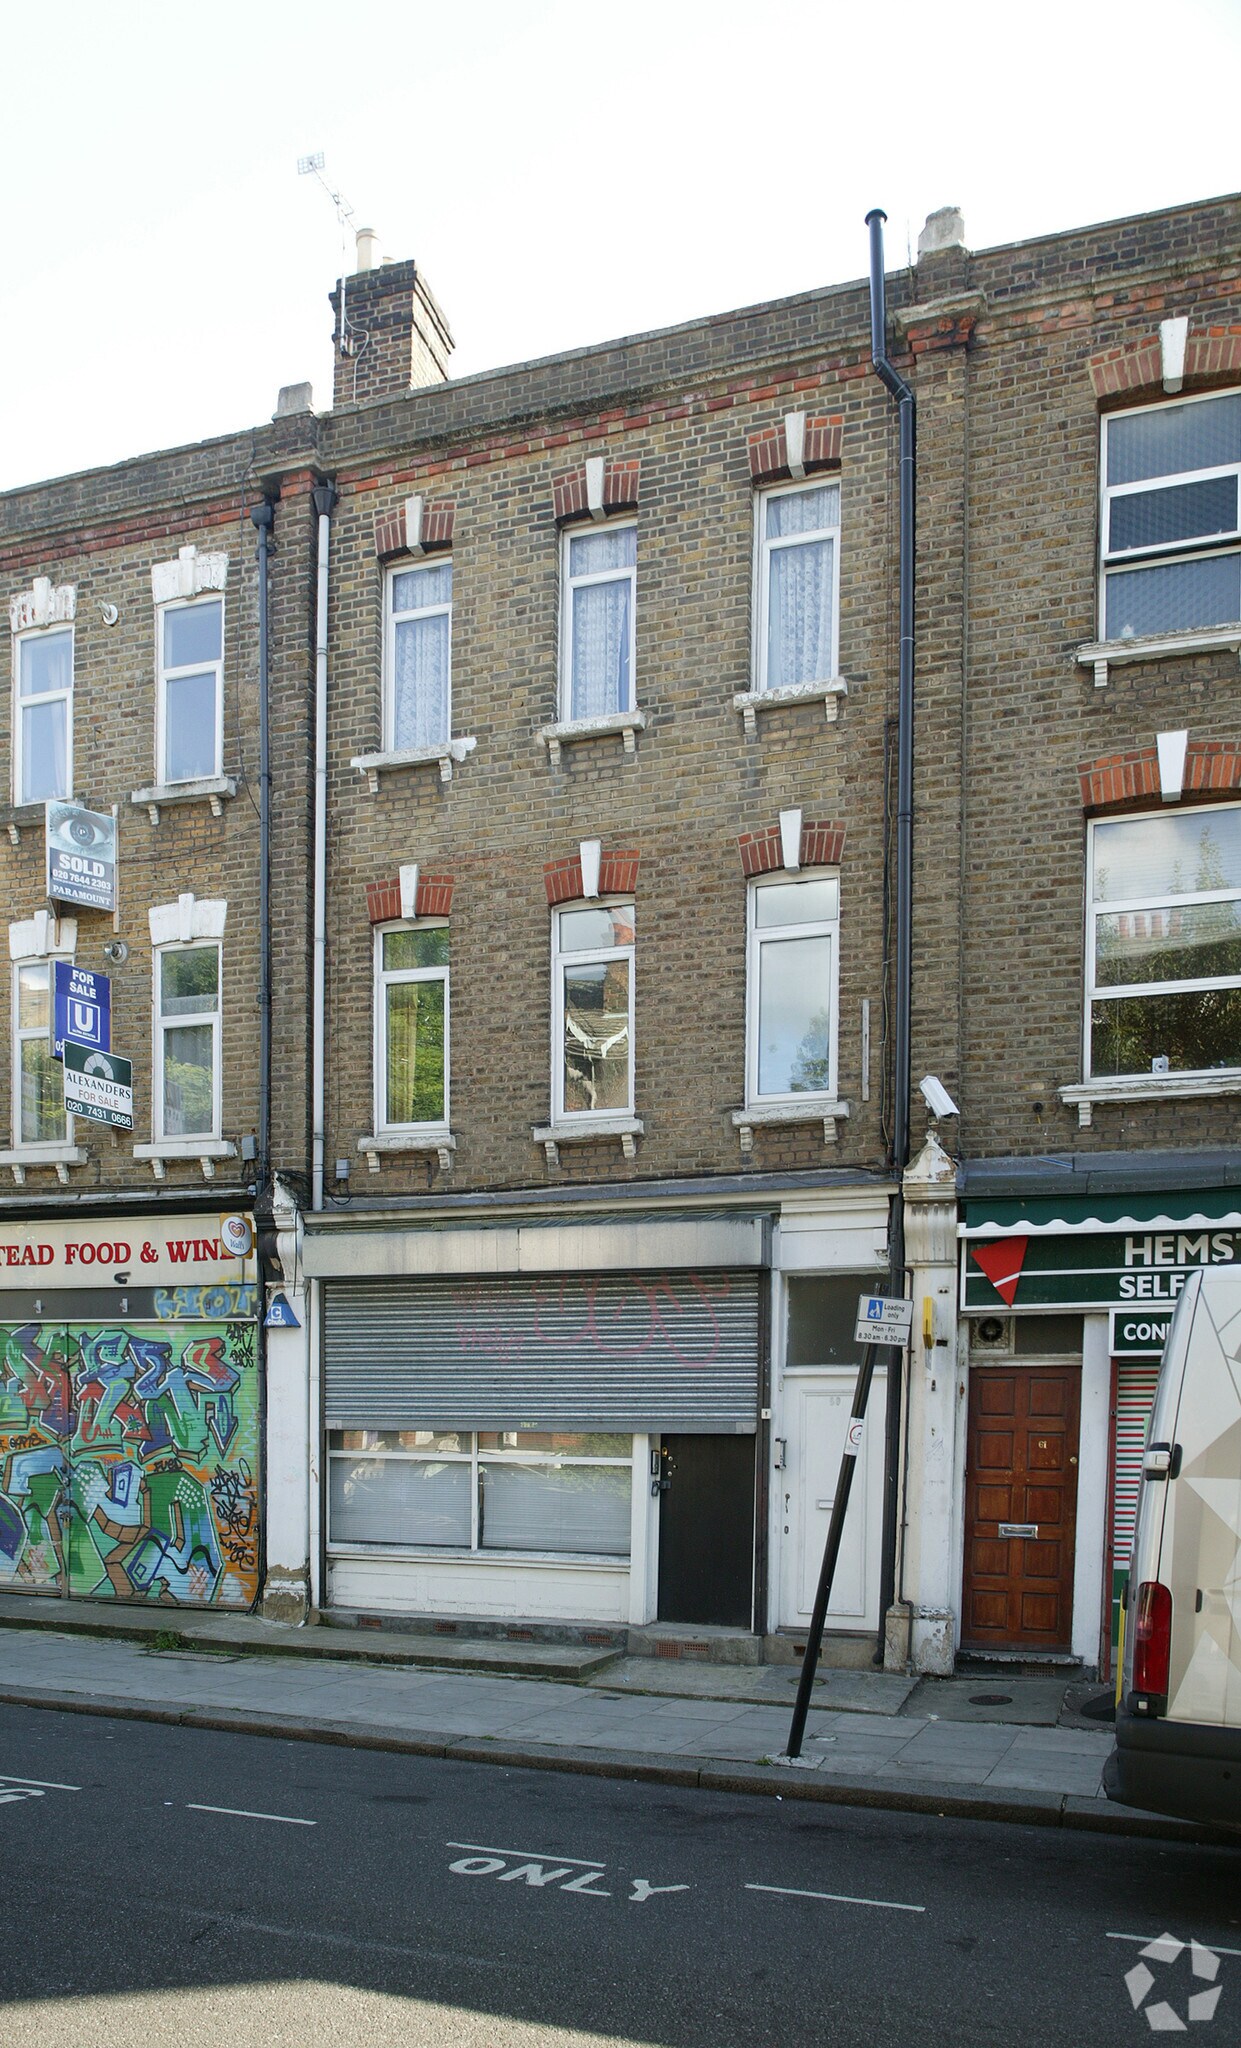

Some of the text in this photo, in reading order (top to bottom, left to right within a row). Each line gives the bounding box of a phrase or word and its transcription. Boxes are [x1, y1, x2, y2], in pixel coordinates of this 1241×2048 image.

[59, 854, 105, 877] SOLD
[52, 868, 68, 880] 020
[70, 873, 90, 885] 7644
[92, 878, 111, 890] 2303
[53, 884, 111, 905] PARAMOUNT
[72, 969, 94, 986] FOR
[69, 981, 97, 999] SALE
[74, 1003, 94, 1032] U
[66, 1072, 131, 1099] ALEXANDERS
[78, 1089, 120, 1109] FOR SALE
[67, 1100, 132, 1126] 020 7431 0666
[64, 1242, 132, 1265] FOOD
[140, 1241, 159, 1263] &
[1124, 1233, 1241, 1266] HEMS
[1119, 1274, 1186, 1298] SELF
[884, 1303, 905, 1313] Loading
[887, 1312, 899, 1320] only
[1123, 1323, 1172, 1340] CON
[1038, 1440, 1047, 1449] 61
[448, 1857, 690, 1901] ONLY
